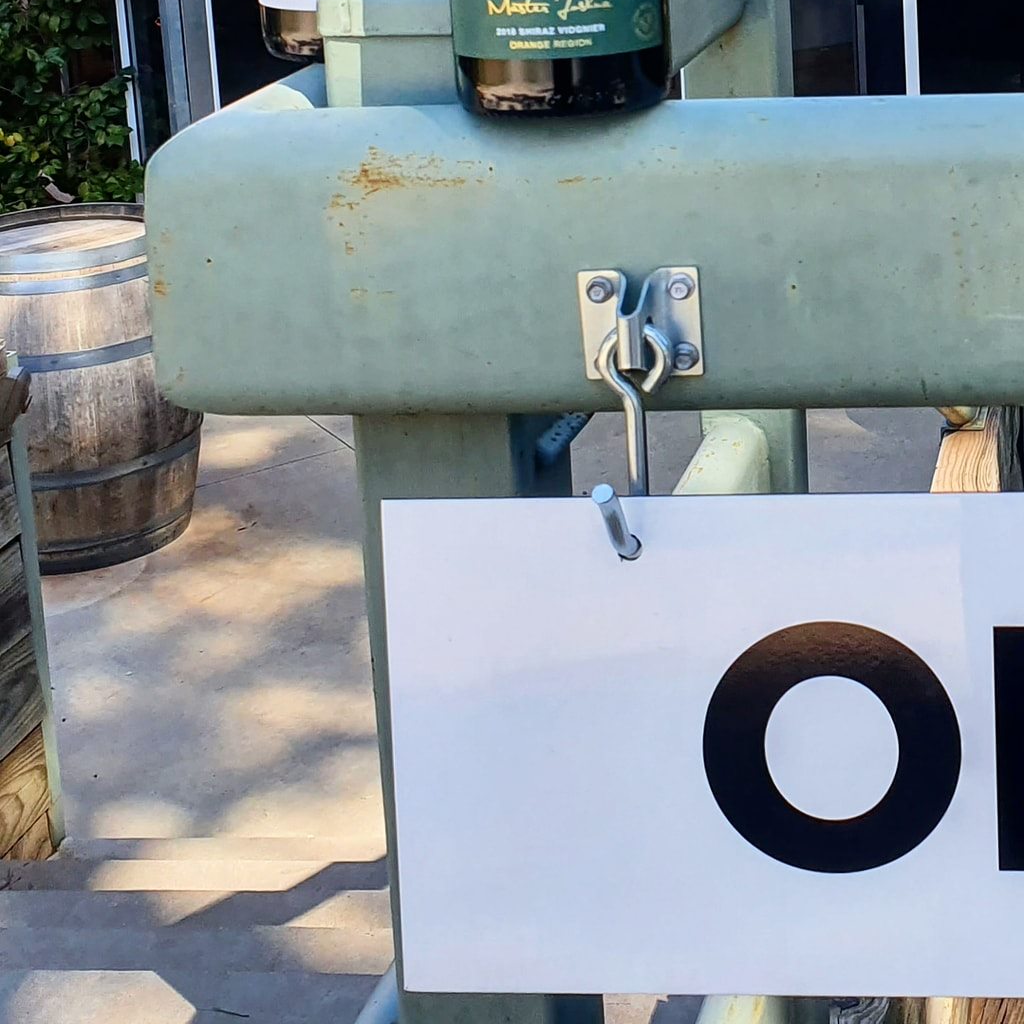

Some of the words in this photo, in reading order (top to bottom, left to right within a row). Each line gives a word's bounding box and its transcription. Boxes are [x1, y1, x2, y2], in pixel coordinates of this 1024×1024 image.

[518, 26, 556, 37] SHIRAZ
[557, 23, 606, 36] VIOGNIER
[509, 39, 550, 51] ORANGE
[552, 37, 593, 49] REGION
